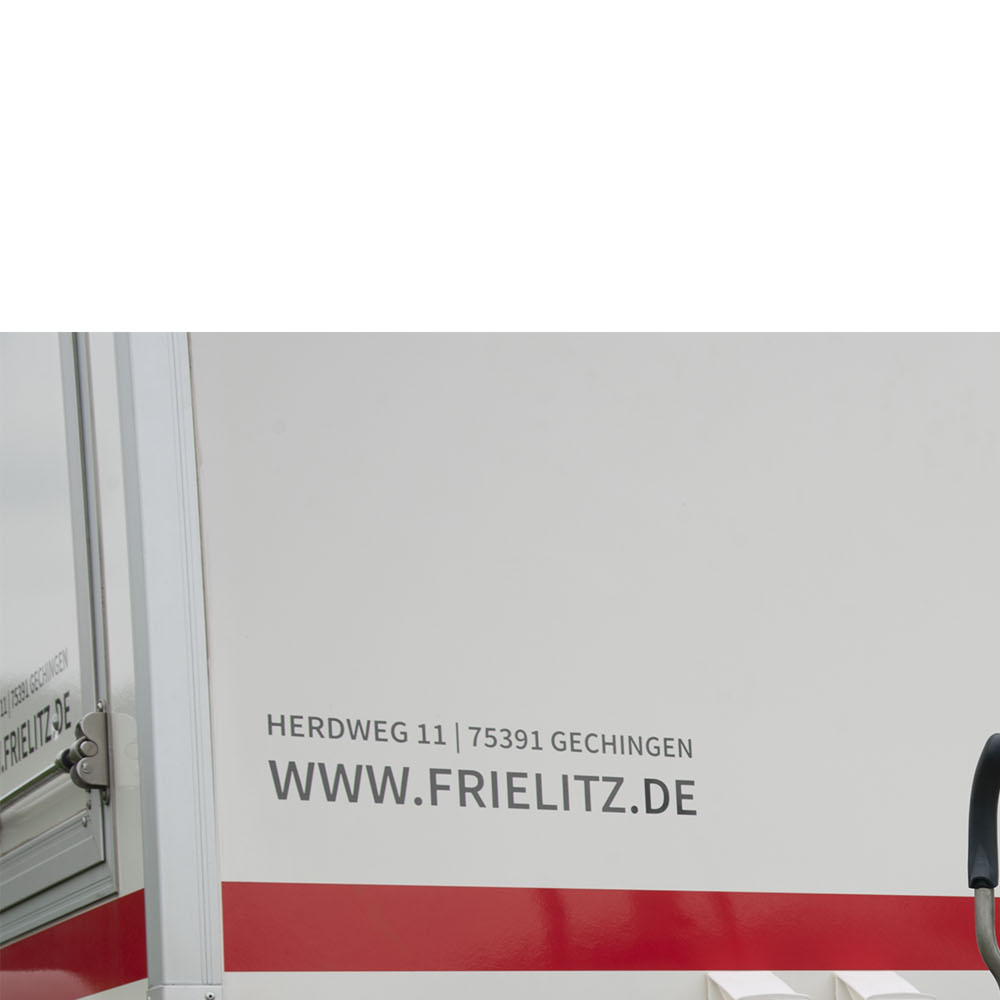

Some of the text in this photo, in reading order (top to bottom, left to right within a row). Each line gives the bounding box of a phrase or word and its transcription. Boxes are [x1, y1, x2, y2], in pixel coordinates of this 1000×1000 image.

[30, 648, 68, 693] GECHINGEN
[267, 713, 408, 744] HERDWEG
[417, 723, 447, 746] 11
[468, 726, 543, 751] 75391
[550, 730, 693, 759] GECHINGEN
[268, 759, 697, 816] WWW.FRIELITZ.DE
